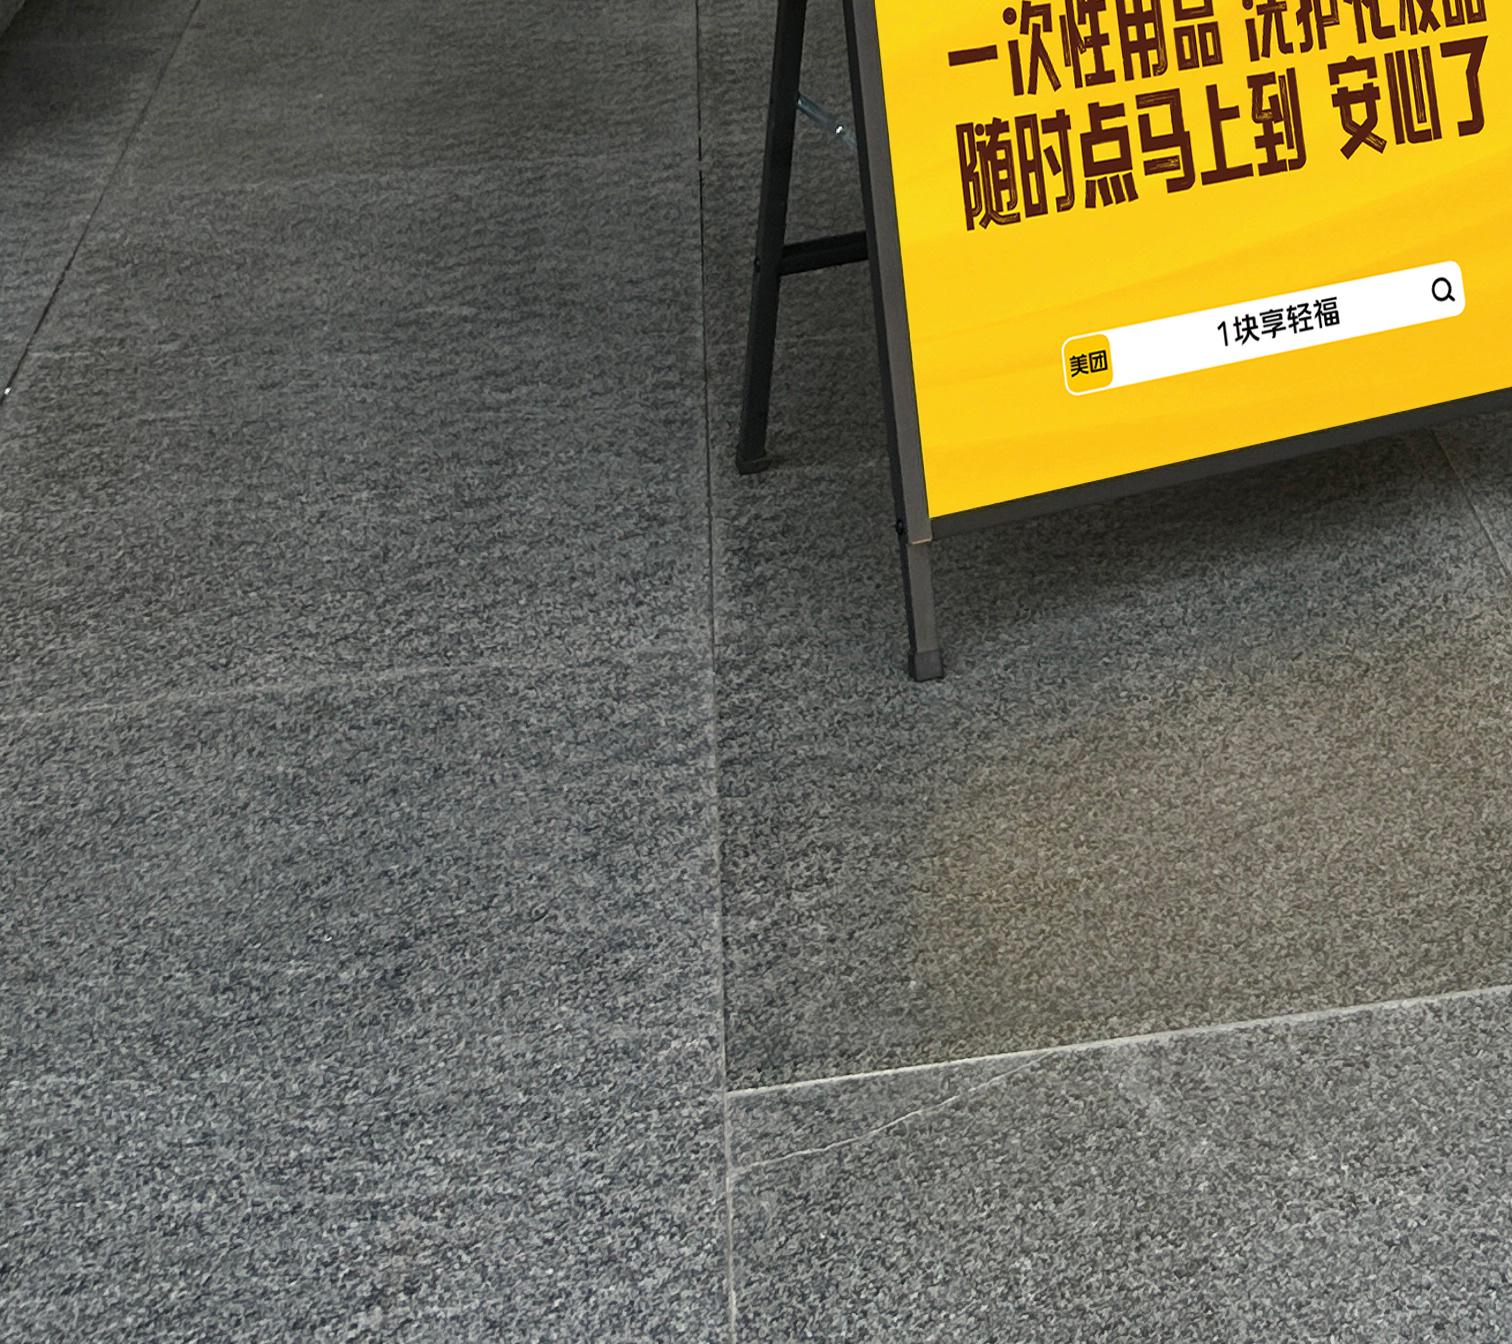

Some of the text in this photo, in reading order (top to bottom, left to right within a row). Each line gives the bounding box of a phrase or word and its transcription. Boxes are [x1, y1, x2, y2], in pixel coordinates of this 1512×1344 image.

[955, 35, 1489, 231] 随时点马上到 安心了
[1217, 296, 1340, 347] 1块享轻福
[1069, 350, 1108, 378] 美团
